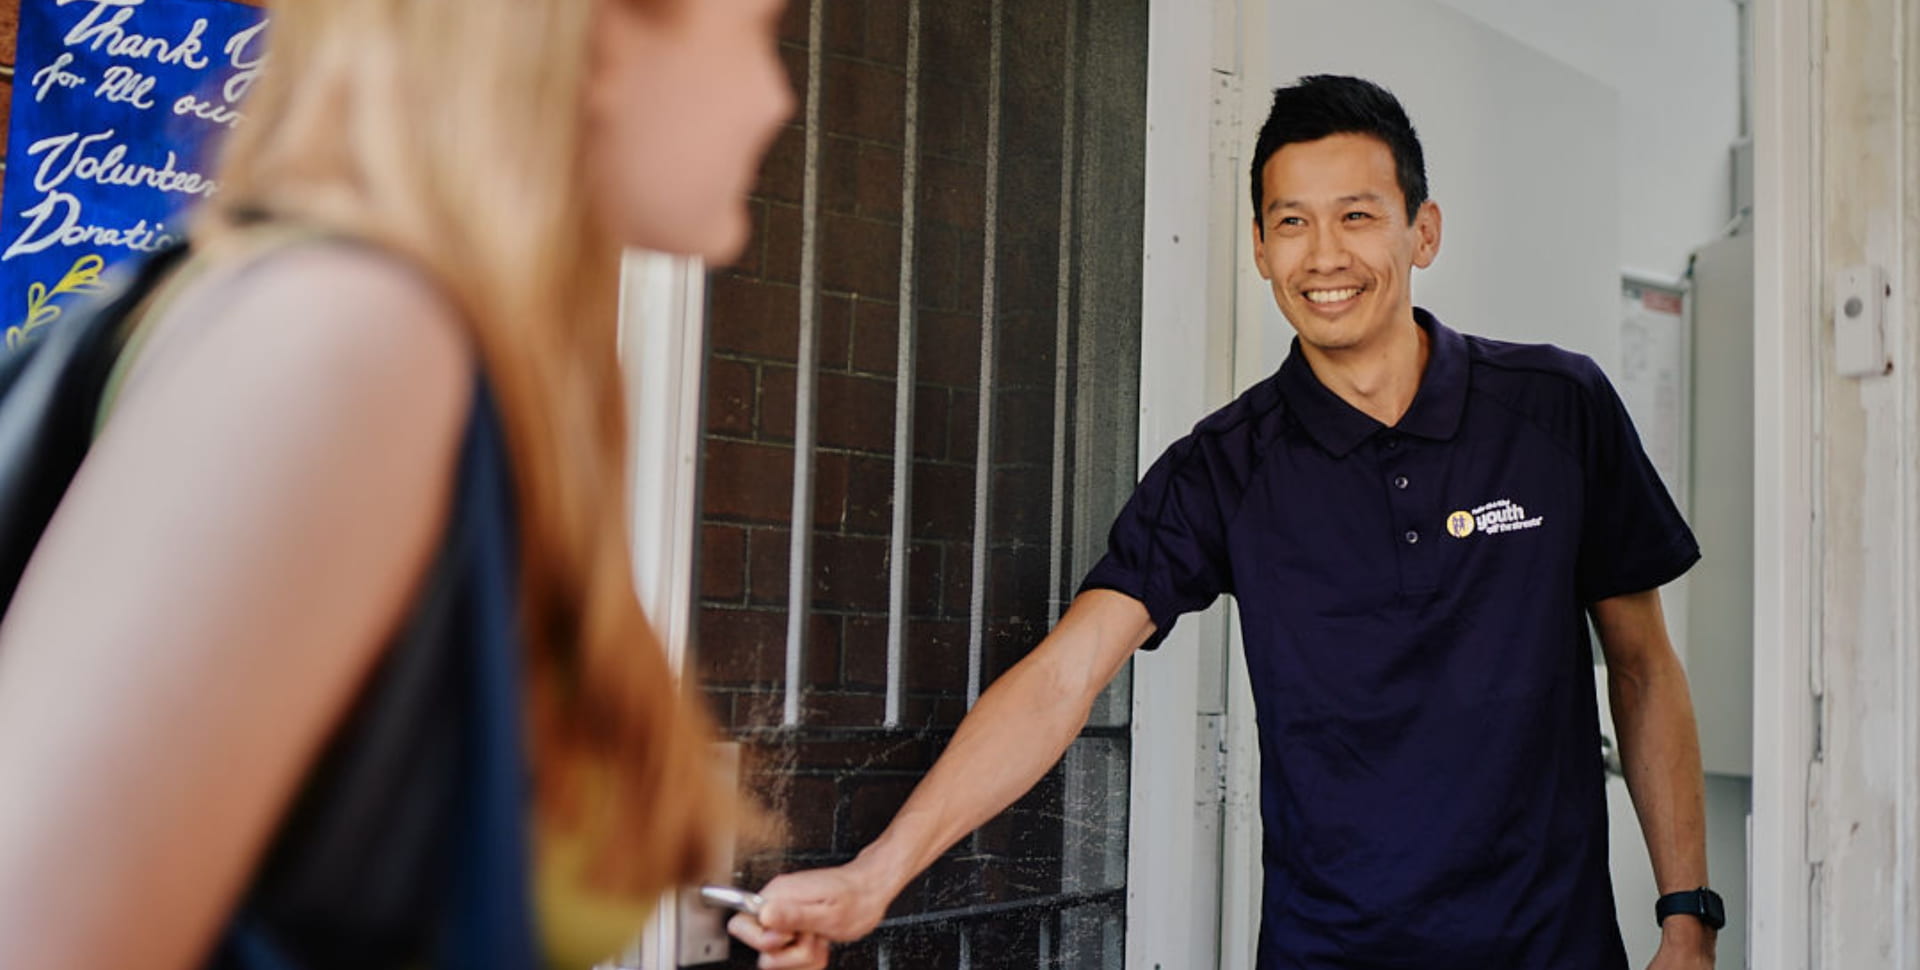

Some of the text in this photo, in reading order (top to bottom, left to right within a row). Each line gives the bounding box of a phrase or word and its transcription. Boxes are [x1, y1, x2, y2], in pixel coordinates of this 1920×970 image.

[57, 0, 210, 70] Thank
[31, 53, 86, 102] for
[1476, 504, 1524, 531] youth
